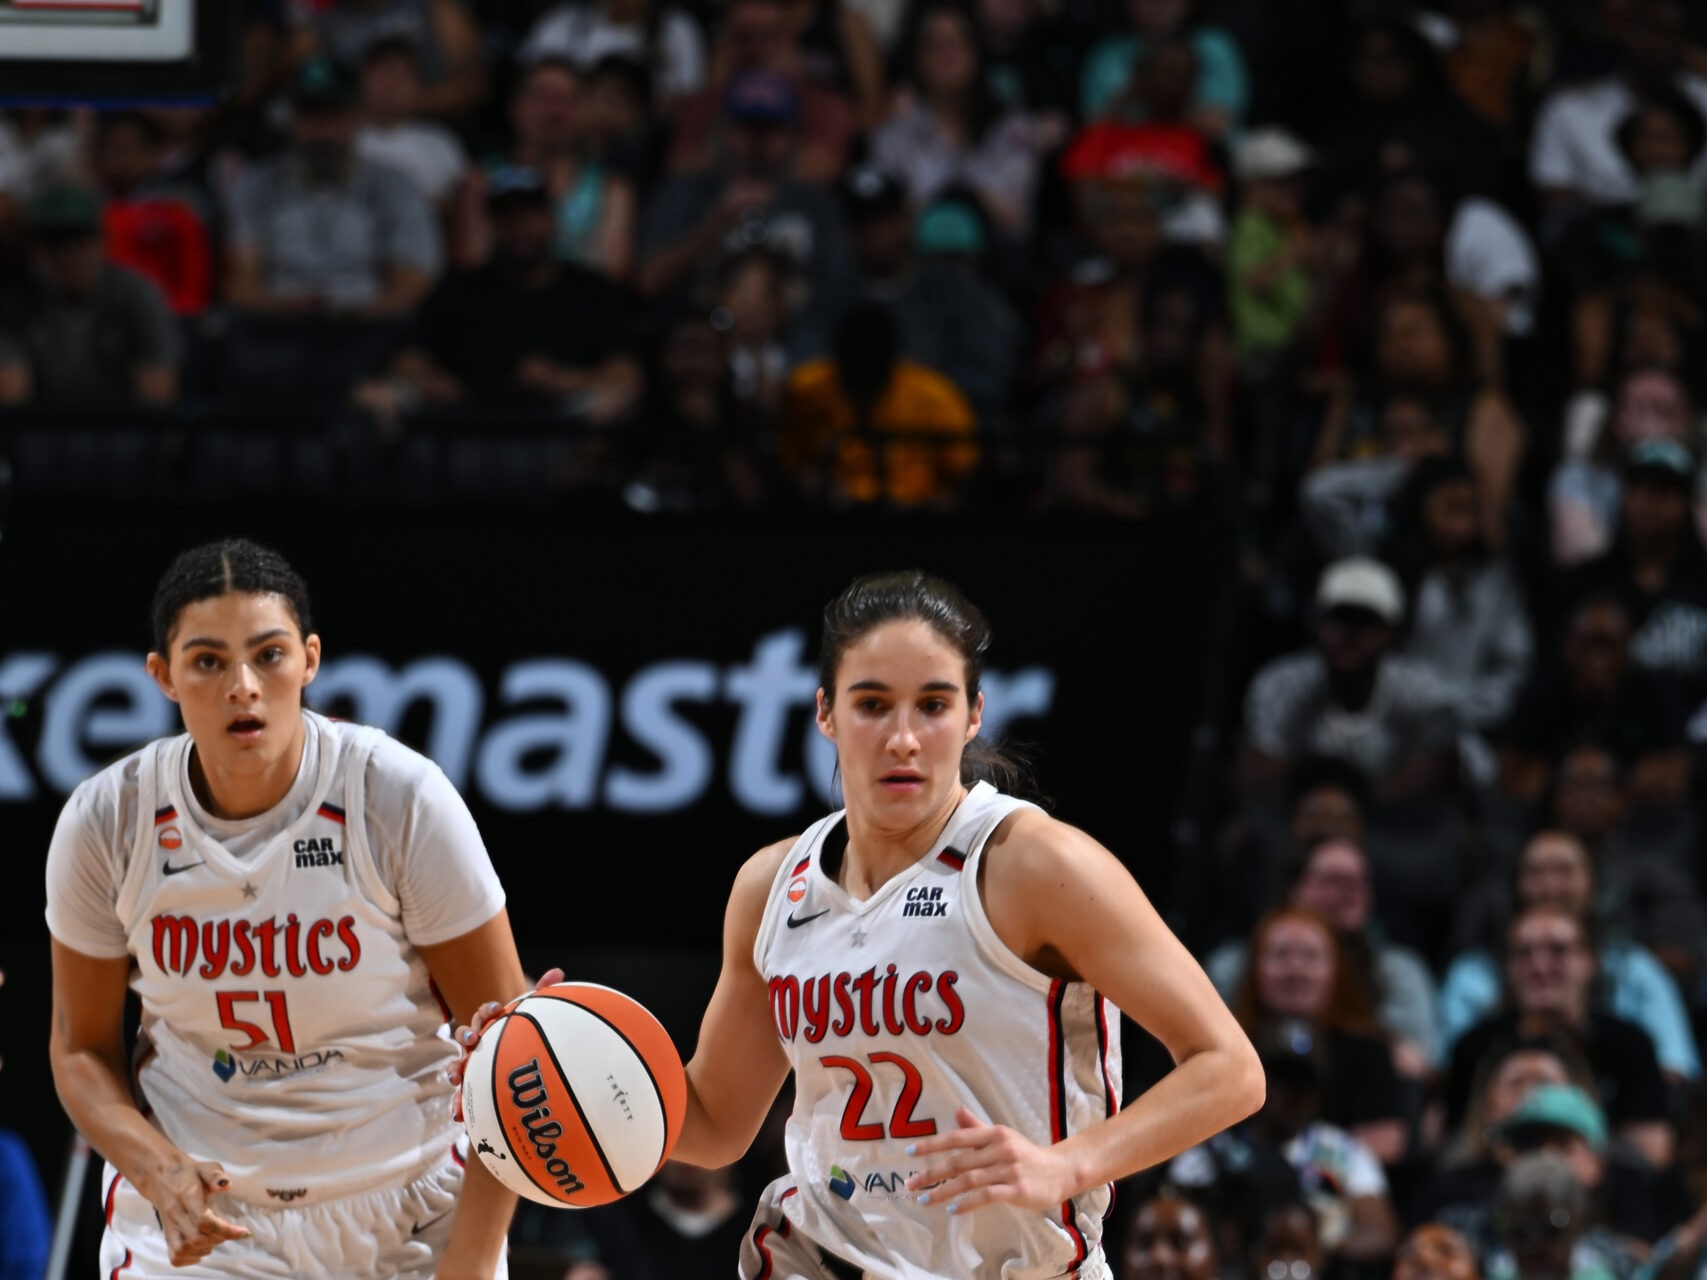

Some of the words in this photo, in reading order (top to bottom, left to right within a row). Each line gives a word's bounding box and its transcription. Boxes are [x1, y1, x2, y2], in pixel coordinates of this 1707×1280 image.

[0, 629, 1056, 814] emastr
[293, 838, 334, 854] CAR
[295, 852, 344, 868] max
[905, 887, 944, 901] CAR
[902, 901, 948, 917] max
[215, 990, 296, 1056] 51
[239, 1049, 345, 1076] VANDA
[819, 1051, 938, 1141] 22
[507, 1057, 585, 1196] Wilson
[852, 1170, 948, 1192] VAN
